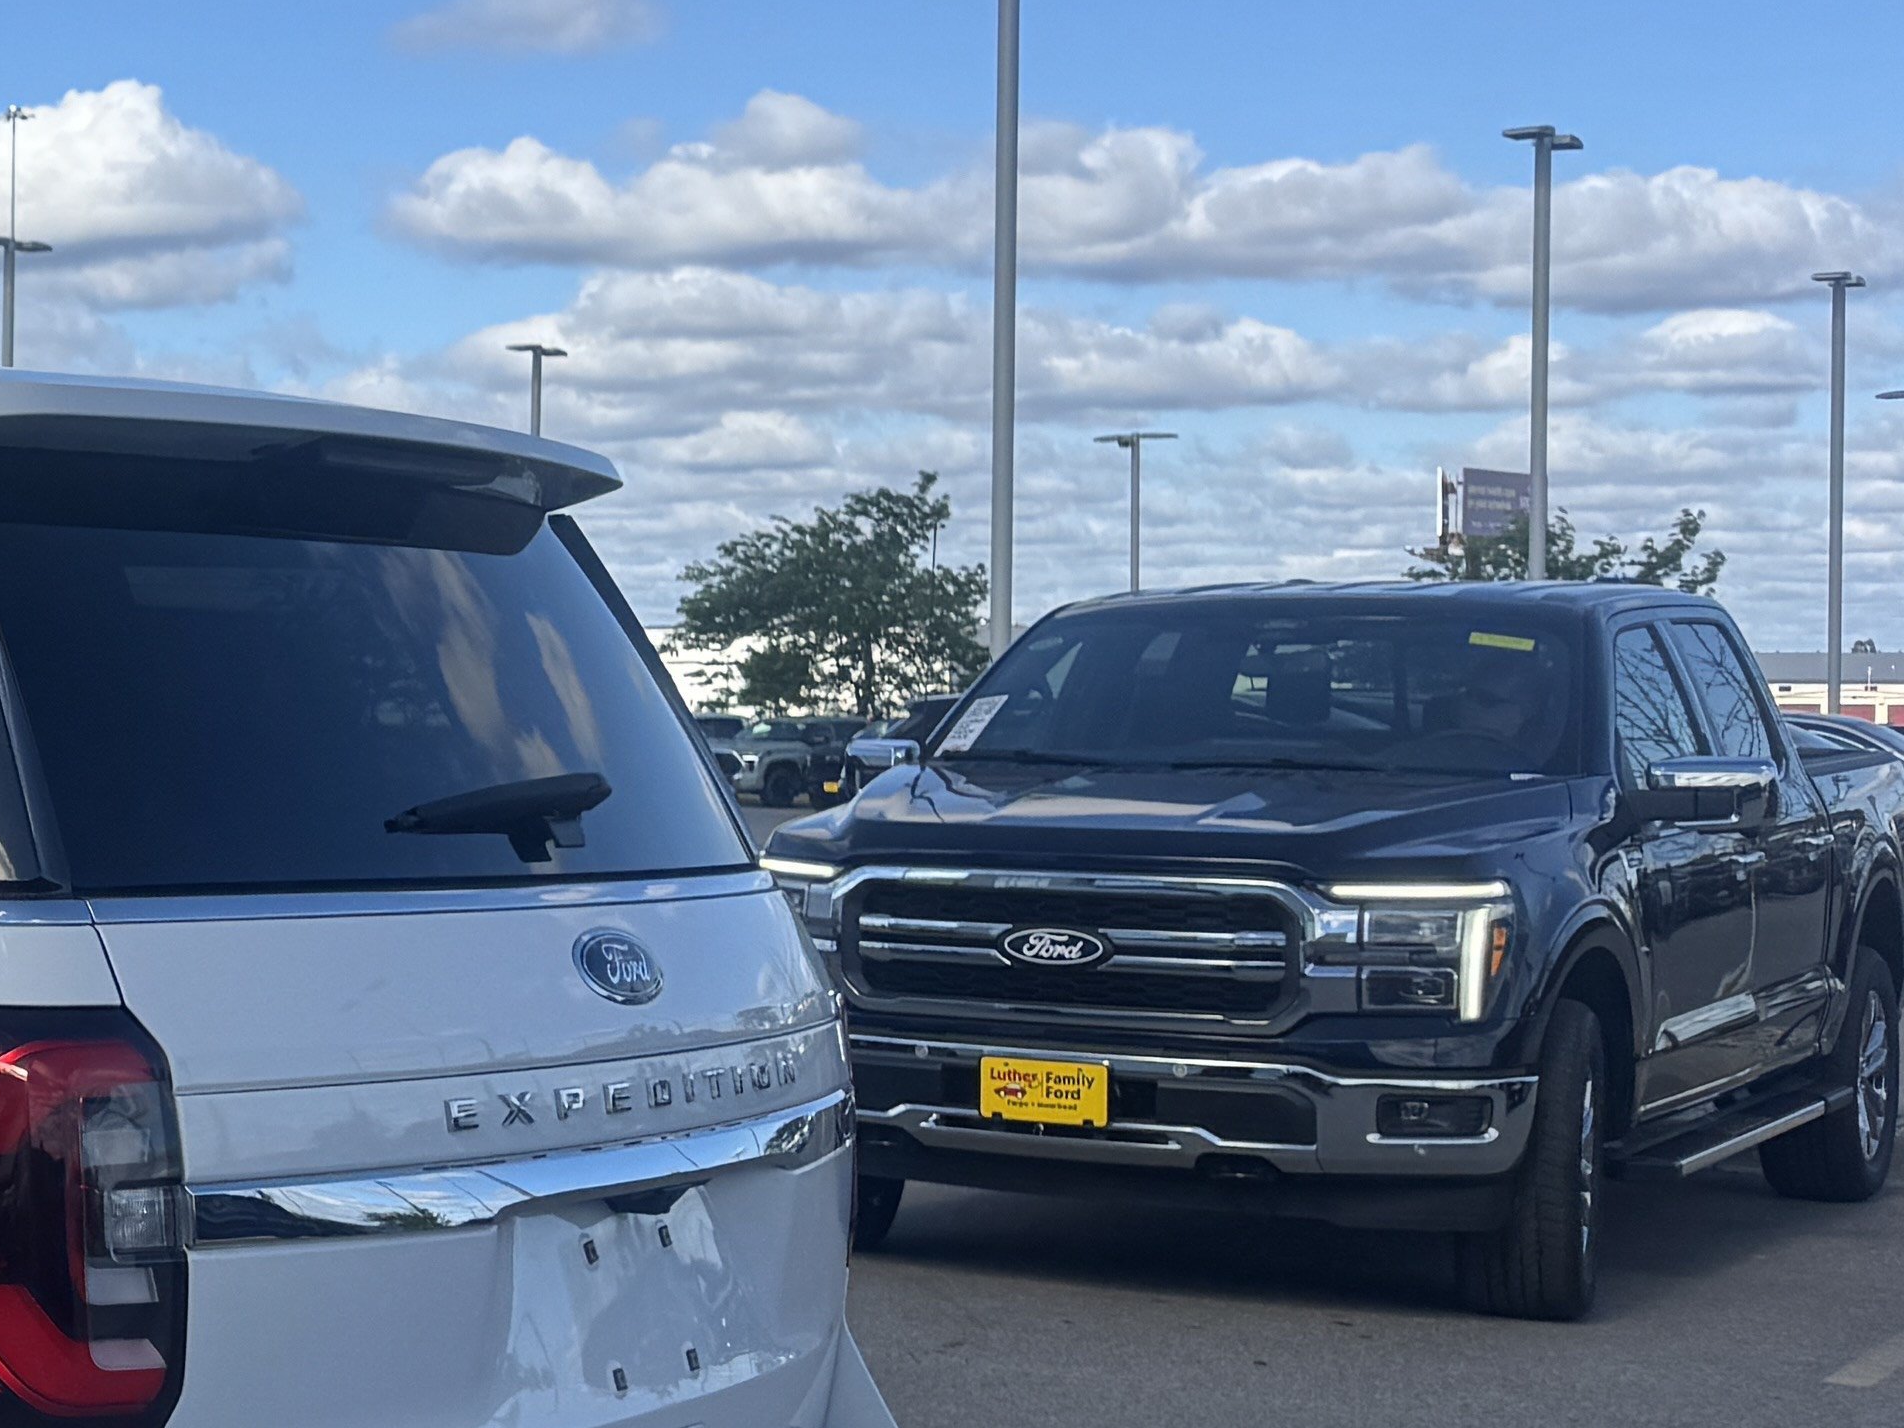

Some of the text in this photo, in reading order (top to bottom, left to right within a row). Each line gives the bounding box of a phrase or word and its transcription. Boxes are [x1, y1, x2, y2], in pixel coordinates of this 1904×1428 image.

[1022, 931, 1084, 960] Ford
[601, 942, 652, 985] Ford
[444, 1049, 798, 1134] EXPEDITION
[990, 1067, 1095, 1090] Luther Family
[1045, 1085, 1082, 1101] Ford
